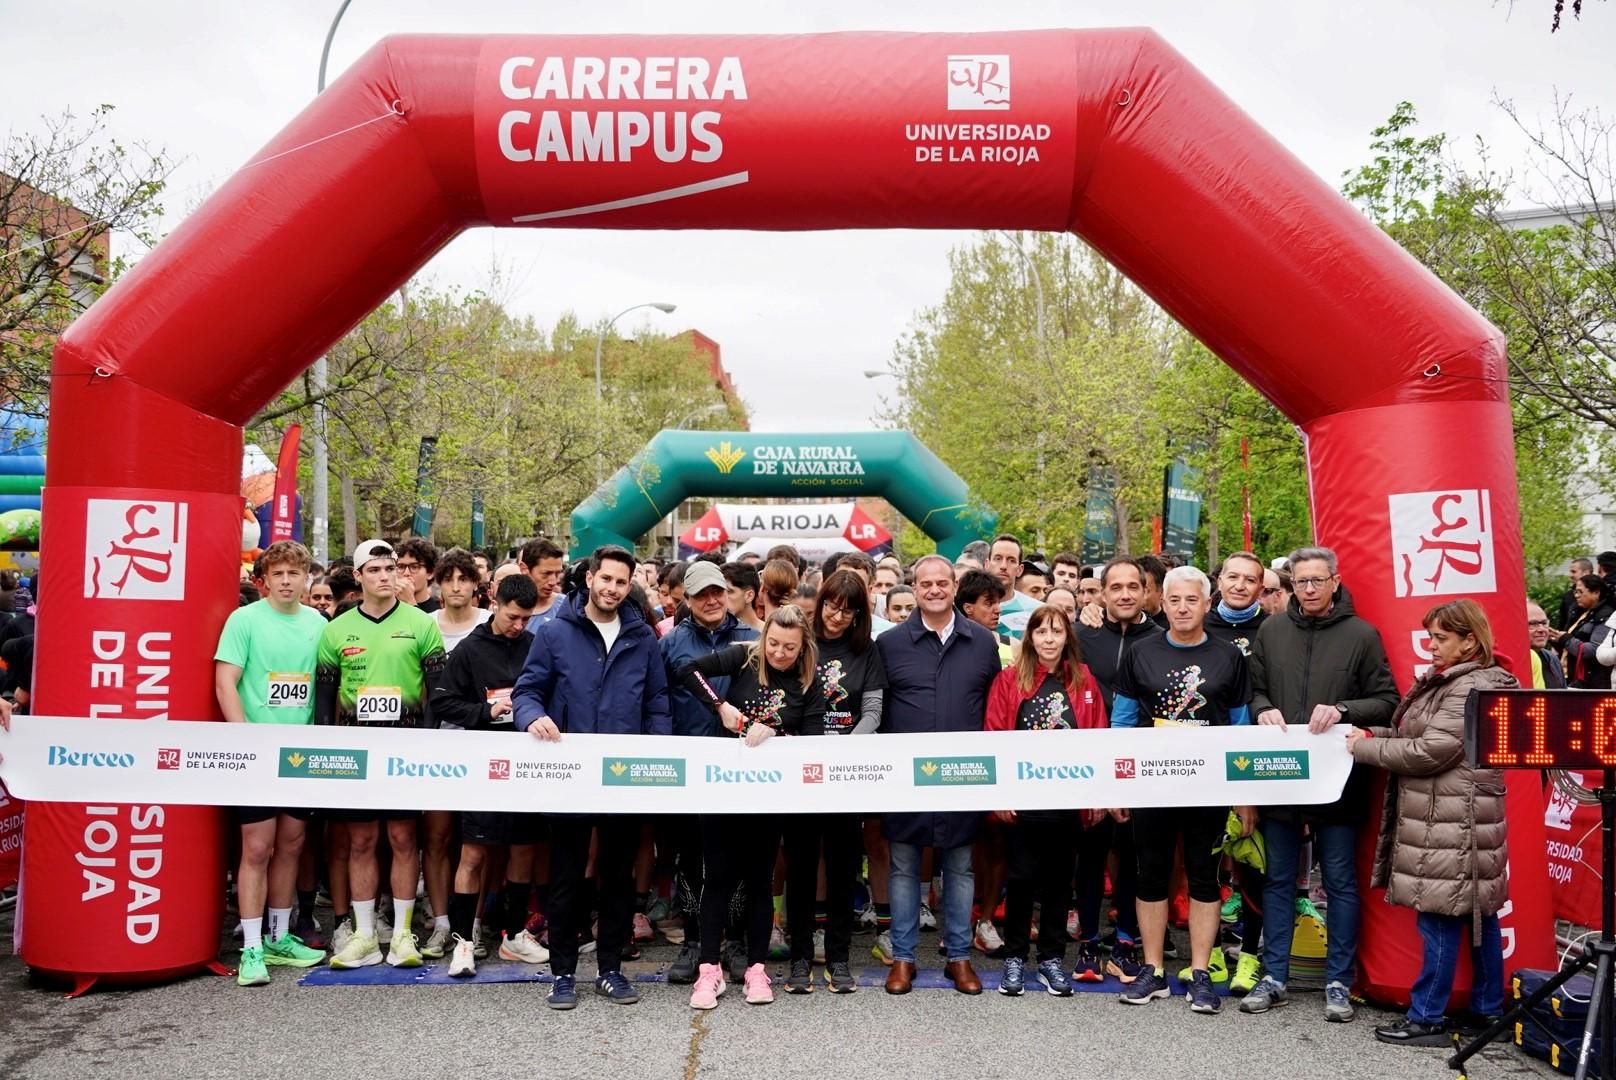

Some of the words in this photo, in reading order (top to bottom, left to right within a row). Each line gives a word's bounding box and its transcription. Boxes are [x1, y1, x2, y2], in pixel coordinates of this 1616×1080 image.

[499, 56, 748, 100] CARRERA
[498, 110, 723, 162] CAMPUS
[905, 124, 1051, 140] UNIVERSIDAD
[915, 146, 943, 162] DE
[949, 146, 975, 162] LA
[981, 146, 1040, 166] RIOJA
[753, 446, 796, 461] CAJA
[799, 446, 857, 460] RURAL
[753, 461, 778, 475] DE
[782, 461, 865, 475] NAVARRA
[791, 477, 826, 486] ACCIÓN
[831, 478, 864, 486] SOCIAL
[736, 514, 766, 530] LA
[771, 513, 840, 530] RIOJA
[695, 528, 721, 542] LR
[850, 524, 877, 539] LR
[90, 630, 126, 689] DE
[270, 683, 308, 700] 2049
[359, 697, 398, 713] 2030
[48, 746, 135, 768] Berceo
[187, 752, 257, 761] UNIVERSIDAD
[330, 755, 356, 763] RURAL
[1141, 759, 1205, 768] UNIVERSIDAD
[186, 761, 200, 769] DE
[202, 761, 215, 769] LA
[218, 761, 247, 771] RIOJA
[308, 761, 320, 769] DE
[321, 762, 359, 770] NAVARRA
[388, 757, 468, 778] Berceo
[516, 762, 581, 770] UNIVERSIDAD
[829, 764, 893, 773] UNIVERSIDAD
[1017, 760, 1094, 780] Berceo
[1156, 768, 1168, 776] LA
[1171, 768, 1197, 776] RIOJA
[516, 771, 528, 779] DE
[531, 771, 543, 779] LA
[546, 771, 572, 781] RIOJA
[705, 764, 783, 784] Berceo
[844, 773, 856, 781] LA
[858, 773, 884, 782] RIOJA
[75, 806, 119, 902] IOJA
[1546, 840, 1583, 862] RSIDAD
